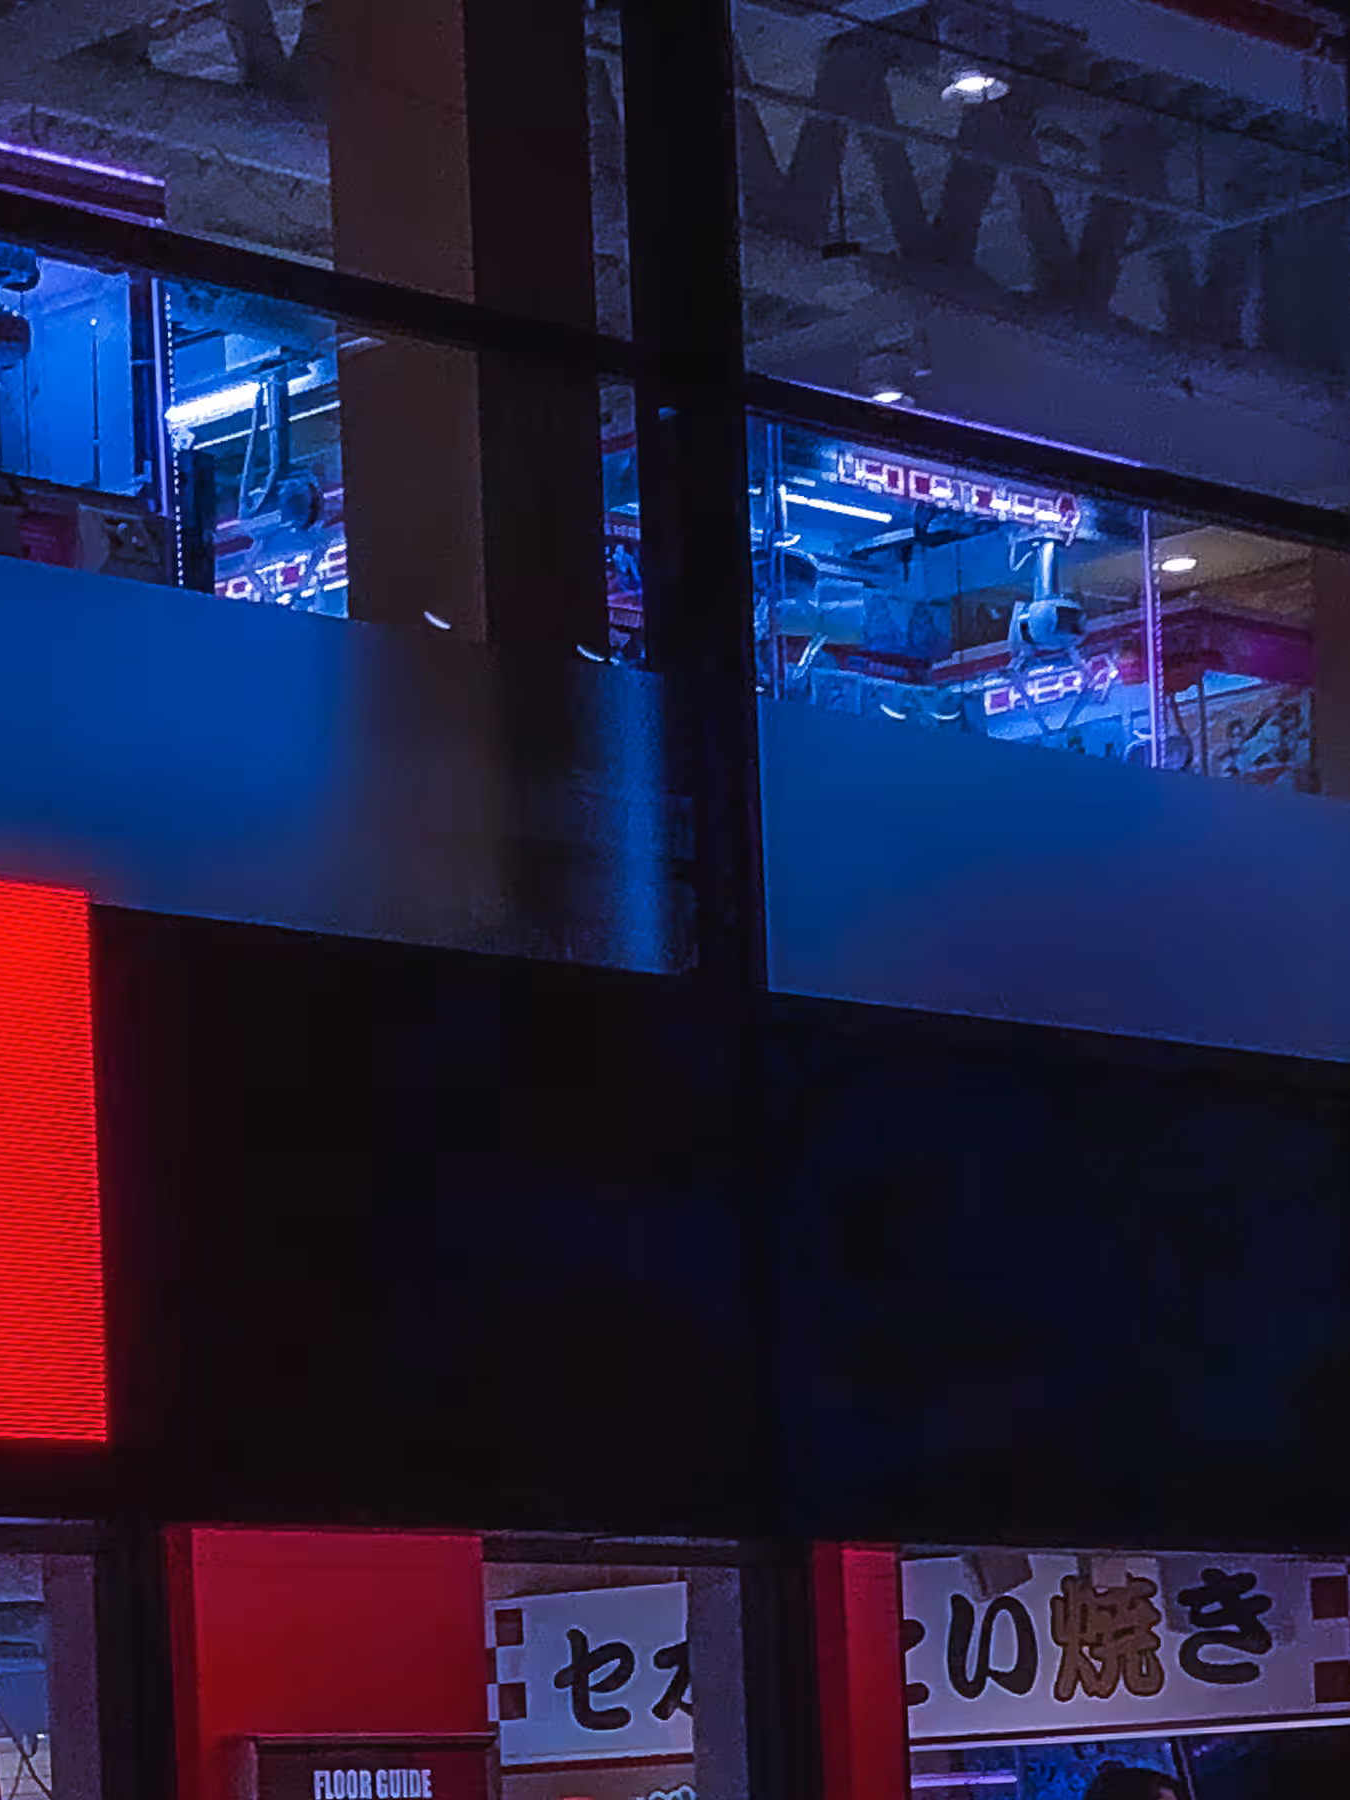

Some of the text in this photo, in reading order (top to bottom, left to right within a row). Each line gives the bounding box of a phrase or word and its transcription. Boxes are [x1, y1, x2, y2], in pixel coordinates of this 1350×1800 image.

[902, 1568, 1274, 1702] い焼き
[313, 1768, 433, 1800] FLOOR GUIDE
